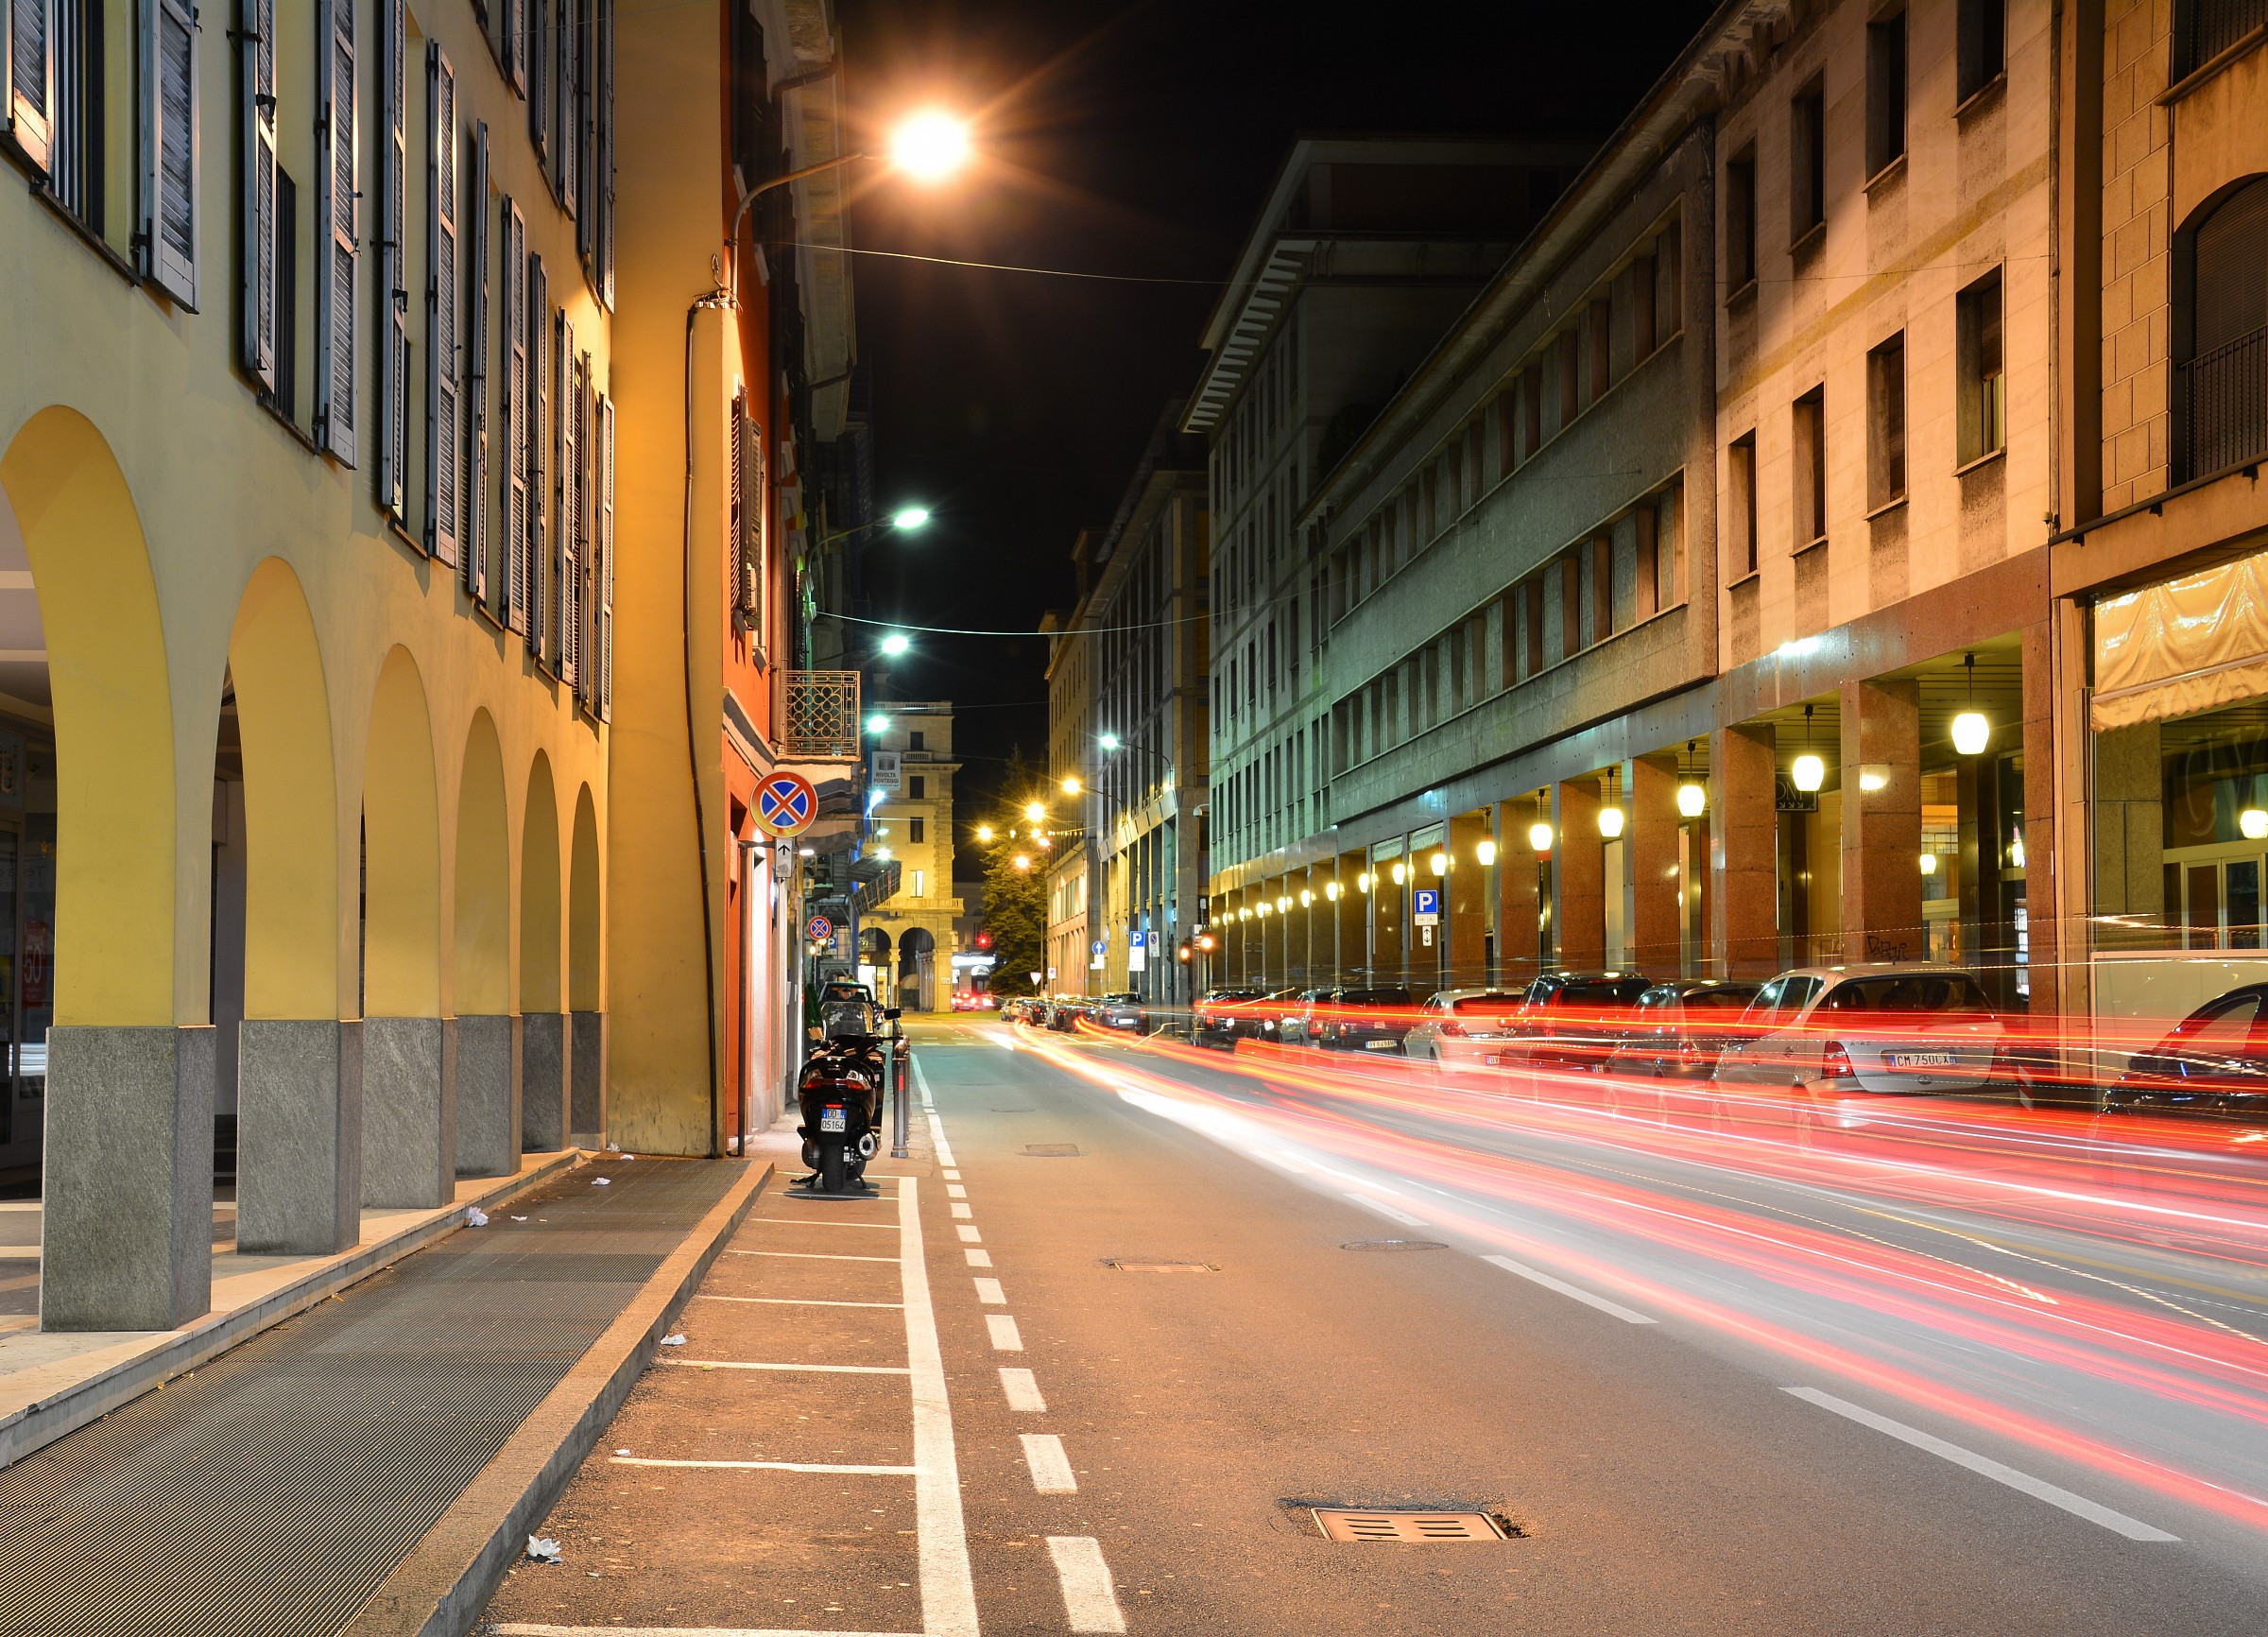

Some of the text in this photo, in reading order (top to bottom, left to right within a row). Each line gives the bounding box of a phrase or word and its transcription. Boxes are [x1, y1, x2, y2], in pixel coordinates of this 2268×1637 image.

[1419, 893, 1433, 911] P
[1133, 933, 1142, 945] P
[1897, 1053, 1950, 1067] CM 750CX
[821, 1120, 845, 1130] 05164
